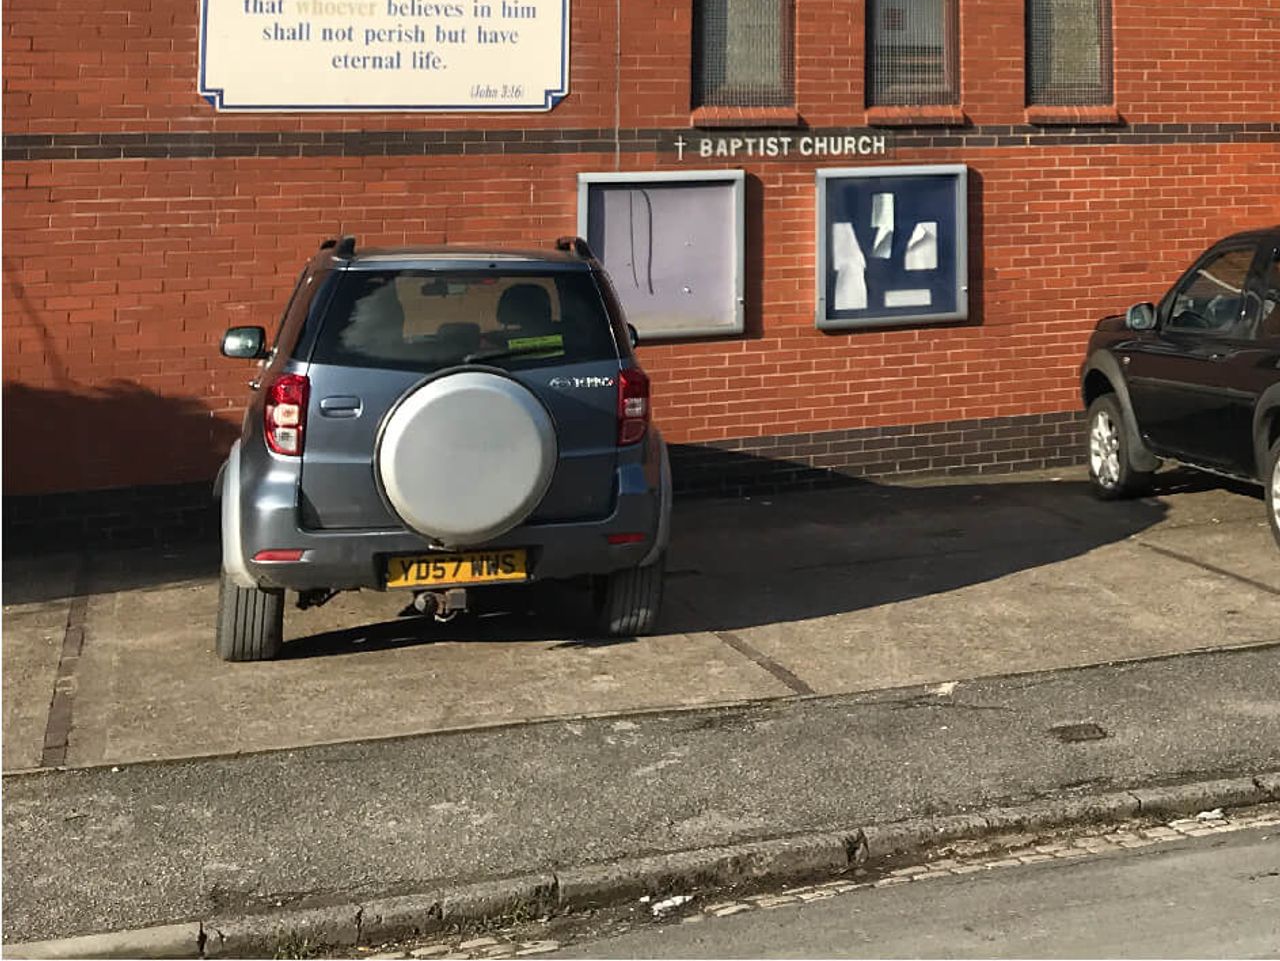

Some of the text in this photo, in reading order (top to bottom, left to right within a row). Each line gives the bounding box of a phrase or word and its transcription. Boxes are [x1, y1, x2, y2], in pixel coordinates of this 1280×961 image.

[473, 0, 492, 17] in
[502, 0, 537, 18] him
[262, 23, 519, 46] shall not perish but have
[331, 51, 447, 69] eternal life.
[700, 136, 886, 157] BAPTIST CHURCH
[400, 557, 464, 581] YD57
